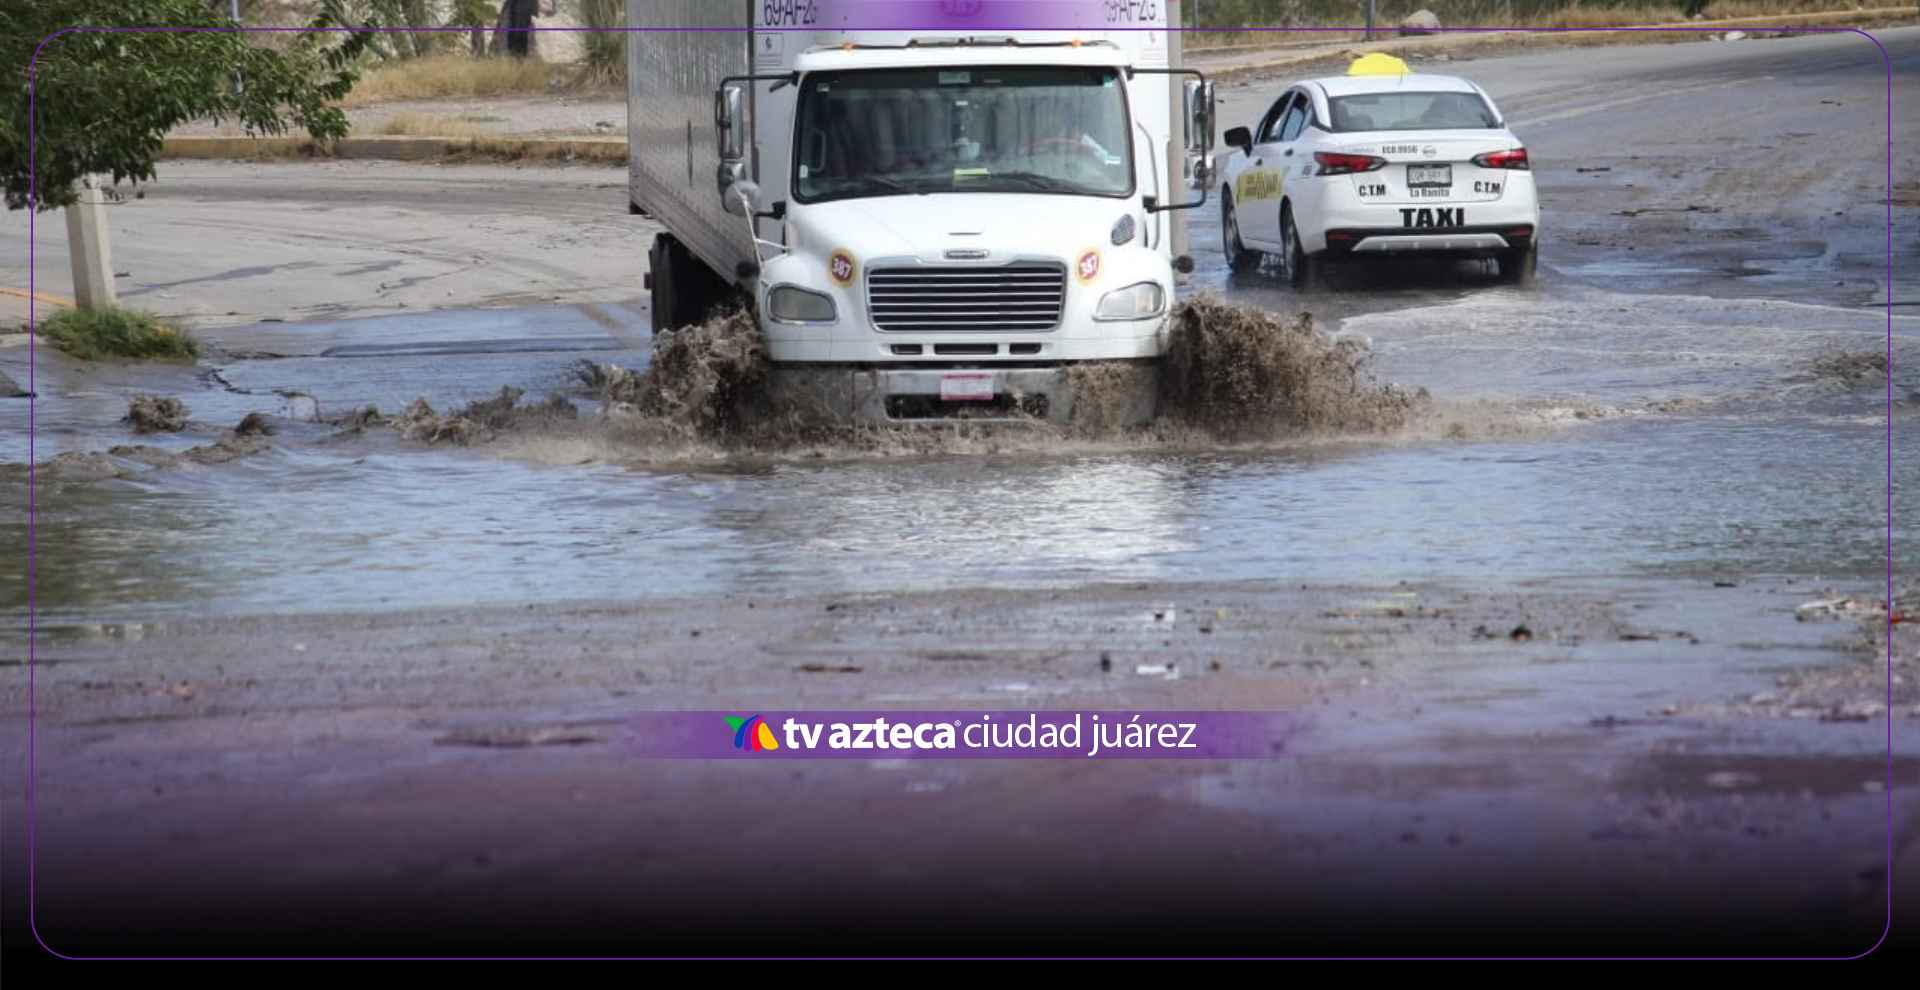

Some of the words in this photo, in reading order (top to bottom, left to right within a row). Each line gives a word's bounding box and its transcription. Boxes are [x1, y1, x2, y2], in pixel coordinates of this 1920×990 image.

[1399, 207, 1465, 228] TAXI
[833, 257, 851, 279] 387
[1081, 255, 1098, 277] 387
